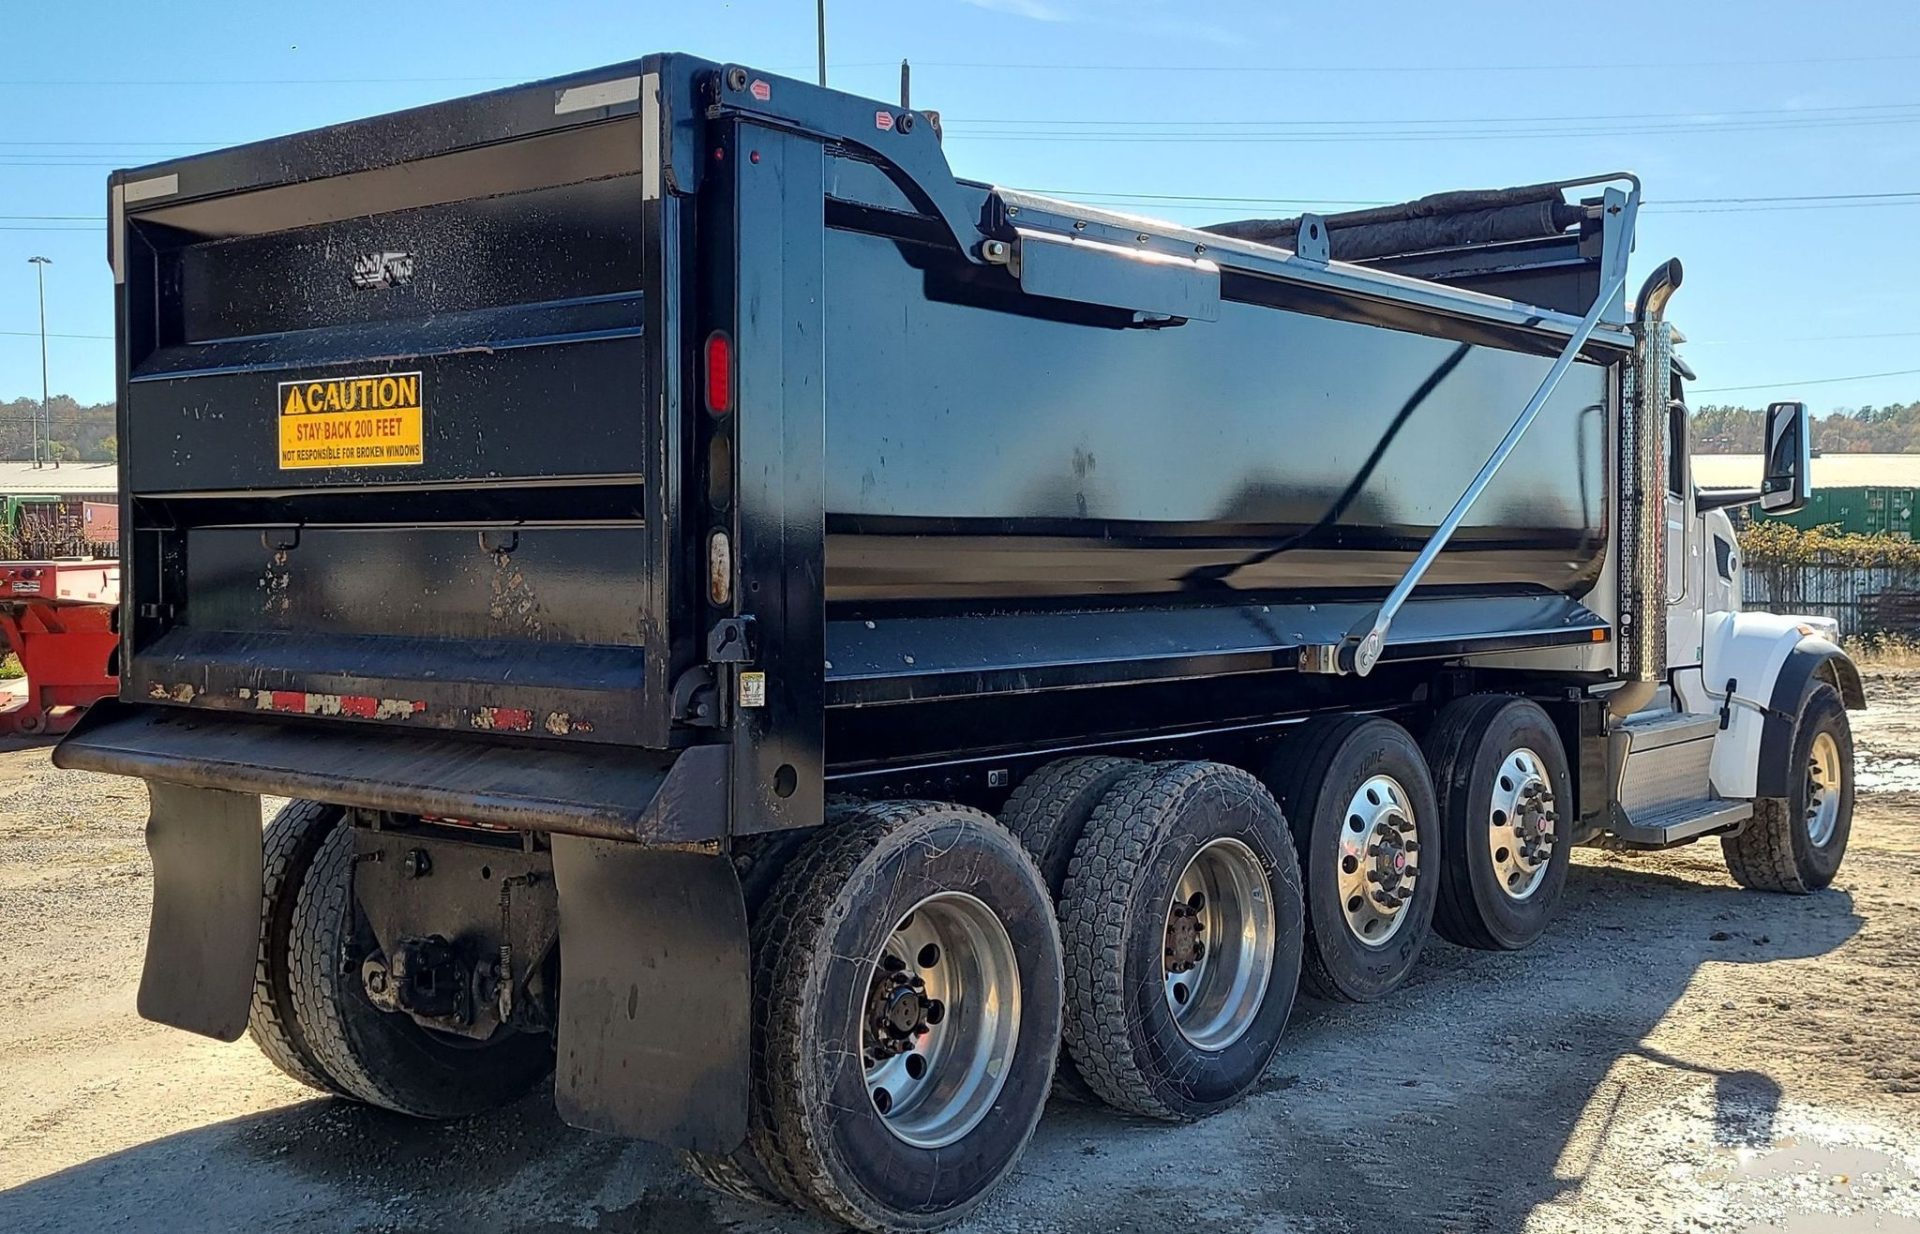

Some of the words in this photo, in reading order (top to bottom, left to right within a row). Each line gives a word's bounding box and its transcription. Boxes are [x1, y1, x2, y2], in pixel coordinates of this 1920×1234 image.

[306, 376, 416, 412] CAUTION
[296, 422, 322, 442] STAY
[324, 420, 352, 440] BACK
[355, 419, 373, 438] 200
[376, 417, 403, 437] FEET
[282, 449, 295, 461] NOT
[296, 447, 341, 461] RESPONSIBLE
[342, 446, 356, 458] FOR
[357, 445, 385, 458] BROKEN
[386, 444, 420, 457] WINDOWS
